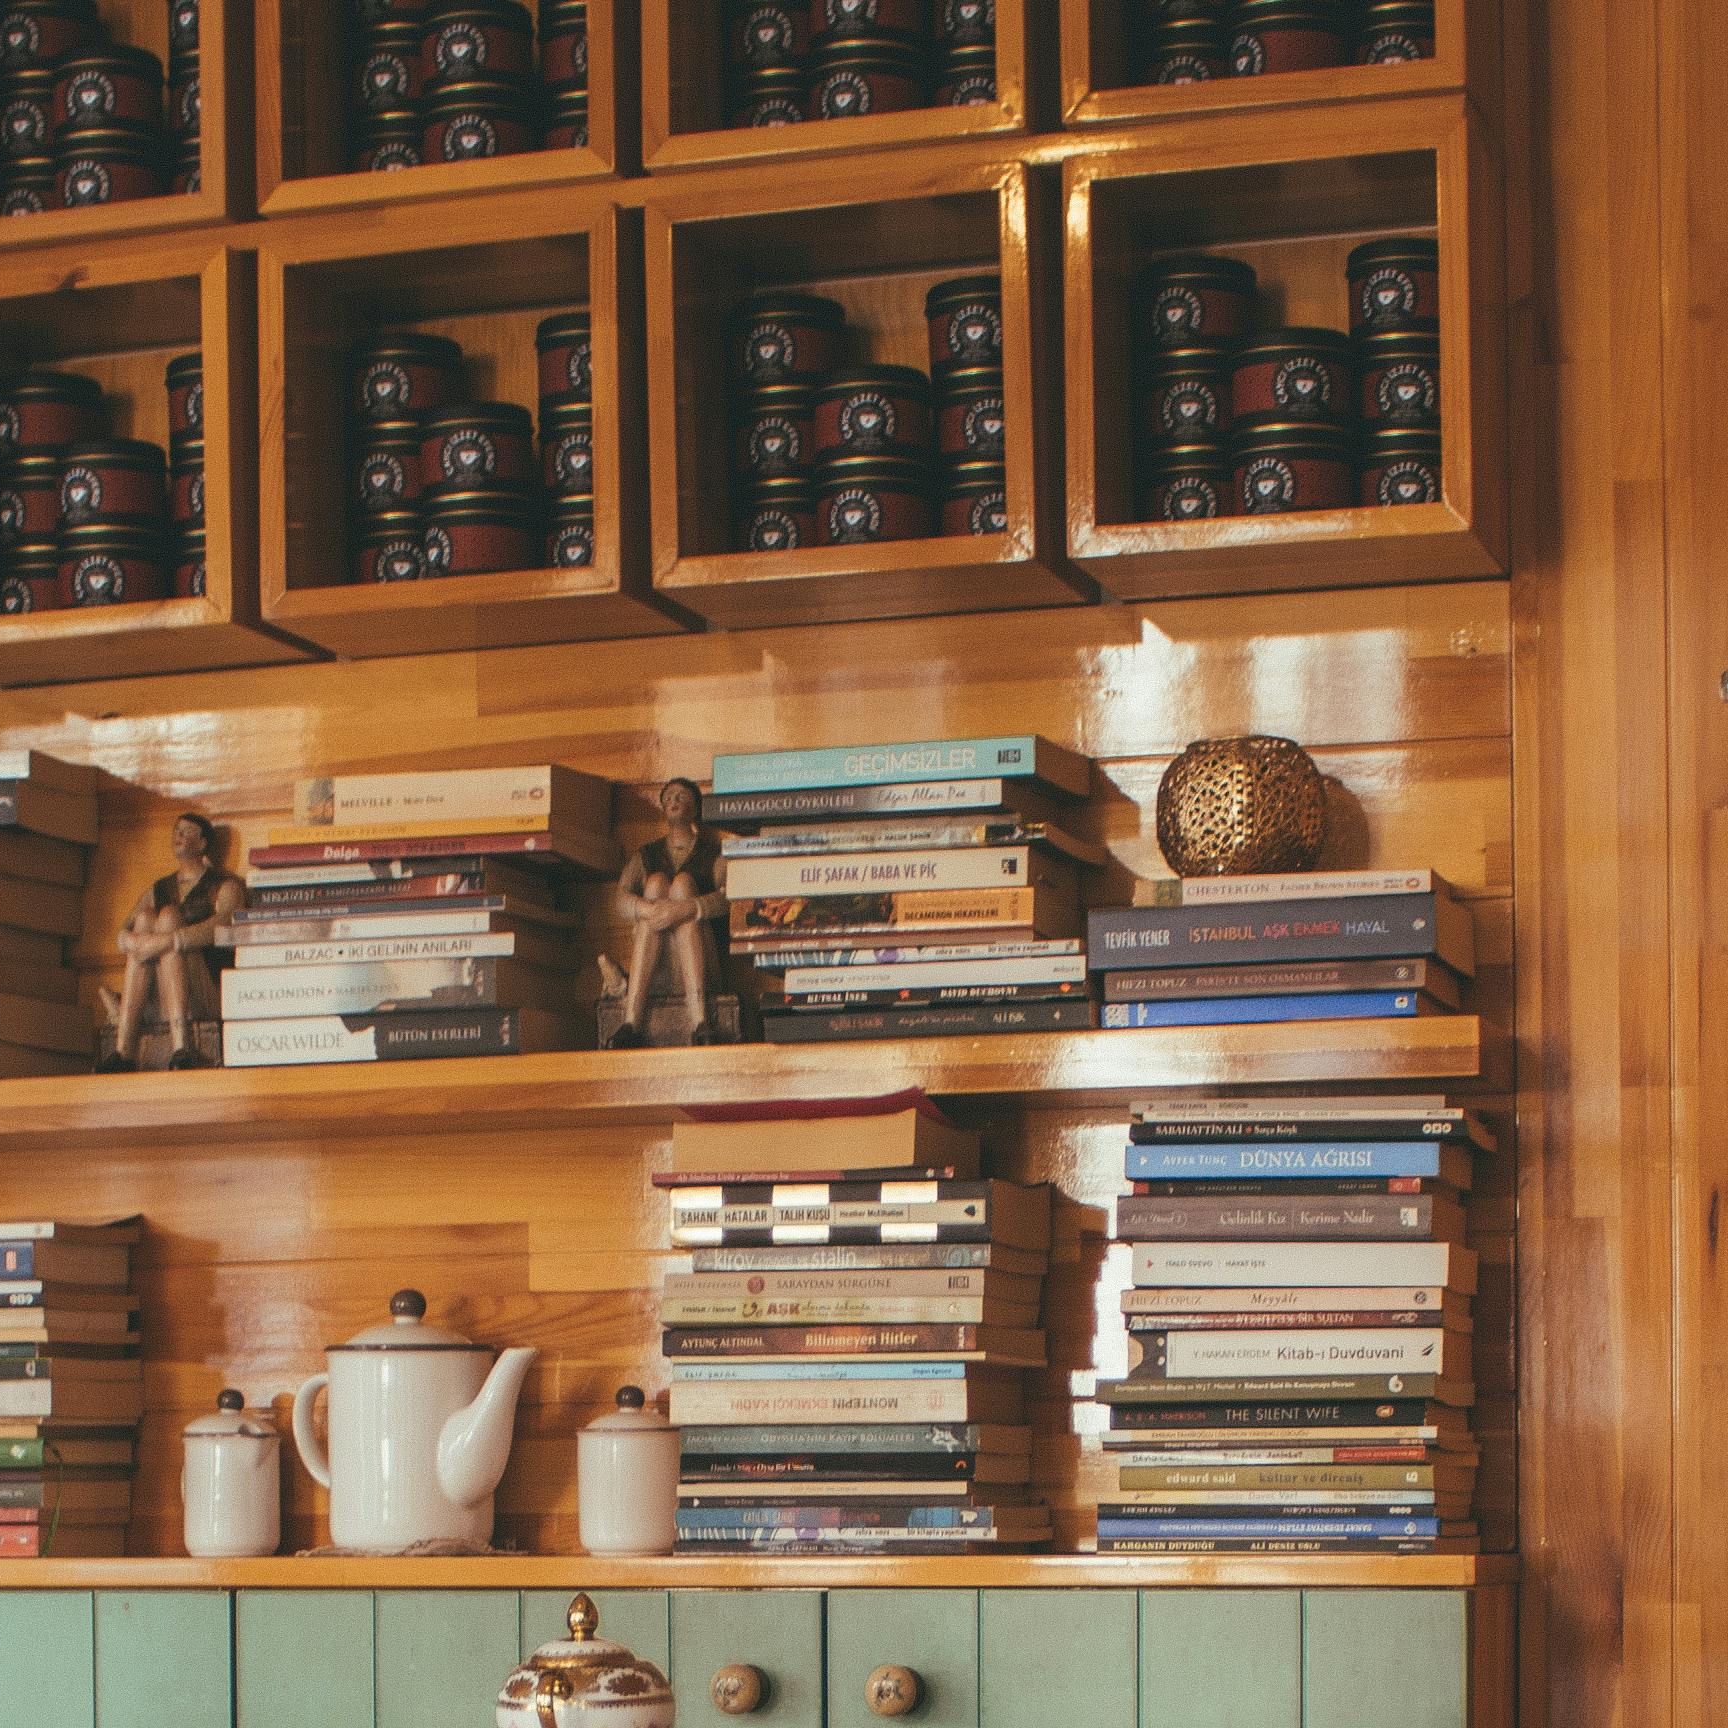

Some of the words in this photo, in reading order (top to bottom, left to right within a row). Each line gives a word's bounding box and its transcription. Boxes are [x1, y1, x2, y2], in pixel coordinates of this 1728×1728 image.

[844, 747, 976, 779] GEÇİMSİZLER
[800, 866, 822, 884] ELİF
[825, 864, 859, 883] ŞAFAK
[870, 864, 901, 879] BABA
[903, 864, 917, 879] VE
[1139, 930, 1171, 947] YENER
[1262, 924, 1290, 941] AŞK
[1345, 920, 1390, 935] HAYAL
[284, 948, 334, 962] BALZAC
[268, 986, 324, 999] LONDON
[237, 1034, 289, 1053] OSCAR
[290, 1033, 345, 1048] WILDE
[1240, 1149, 1306, 1168] DÜNYA
[1311, 1148, 1373, 1167] AĞRISI
[680, 1210, 718, 1226] ŞAHANE
[724, 1208, 767, 1223] HATALAR
[806, 1207, 831, 1223] KUŞU
[1300, 1211, 1341, 1224] Kerime
[681, 1337, 719, 1350] AYTUNÇ
[805, 1334, 878, 1349] Bilinmeyen
[879, 1332, 918, 1346] Hitler
[1276, 1346, 1322, 1360] Kitab-ı
[1328, 1346, 1405, 1359] Duvduvani
[1225, 1408, 1250, 1421] THE
[1255, 1407, 1300, 1421] SILENT
[1304, 1406, 1340, 1420] WIFE
[1212, 1473, 1236, 1484] said
